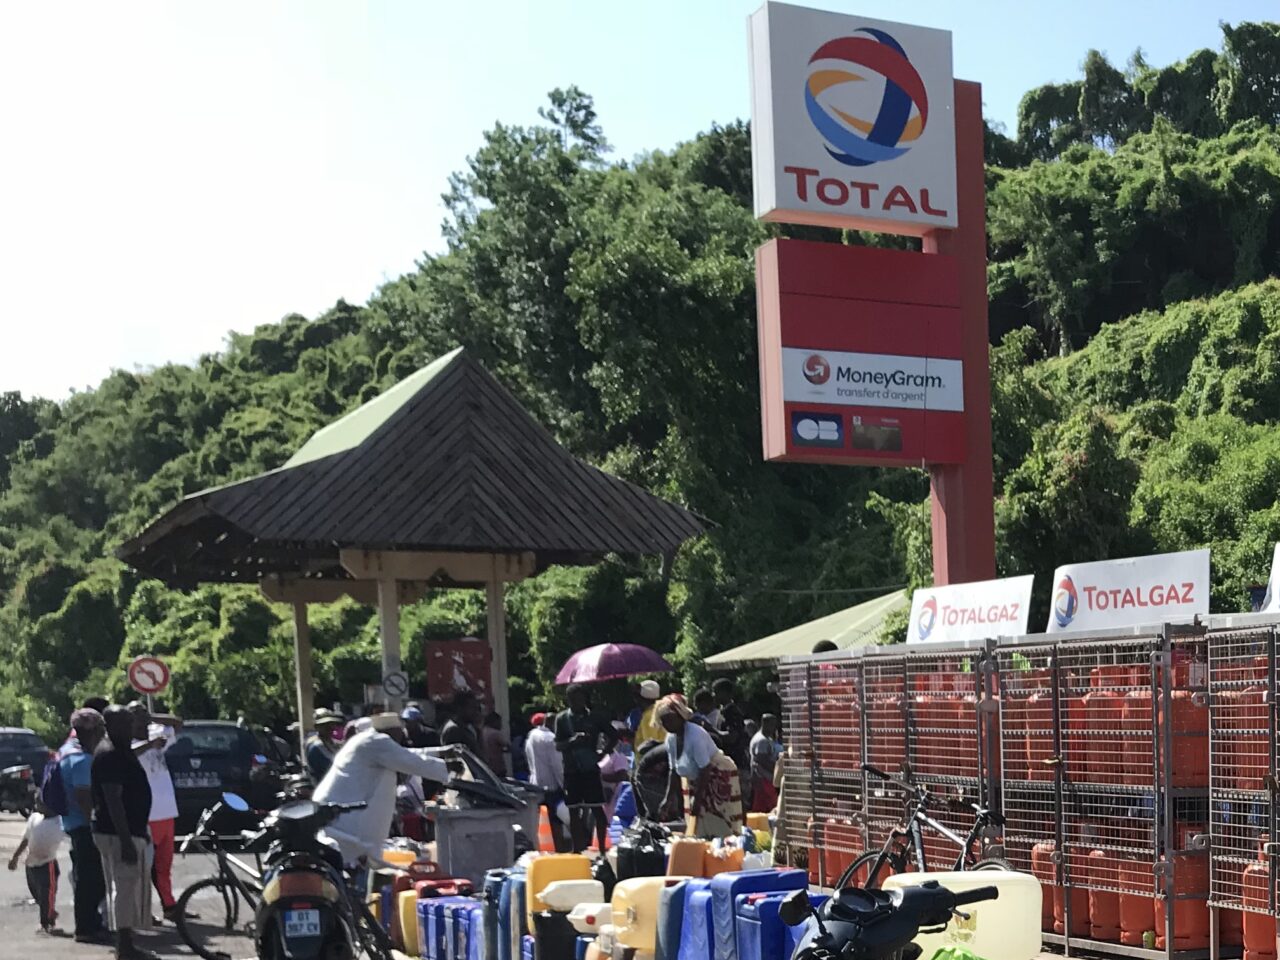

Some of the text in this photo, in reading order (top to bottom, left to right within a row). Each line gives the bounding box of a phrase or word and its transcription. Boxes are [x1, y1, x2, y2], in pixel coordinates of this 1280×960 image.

[784, 166, 948, 218] TOTAL
[837, 387, 925, 403] transfert d'argent
[1083, 582, 1194, 611] TOTALGAZ
[941, 602, 1020, 627] TOTALGAZ
